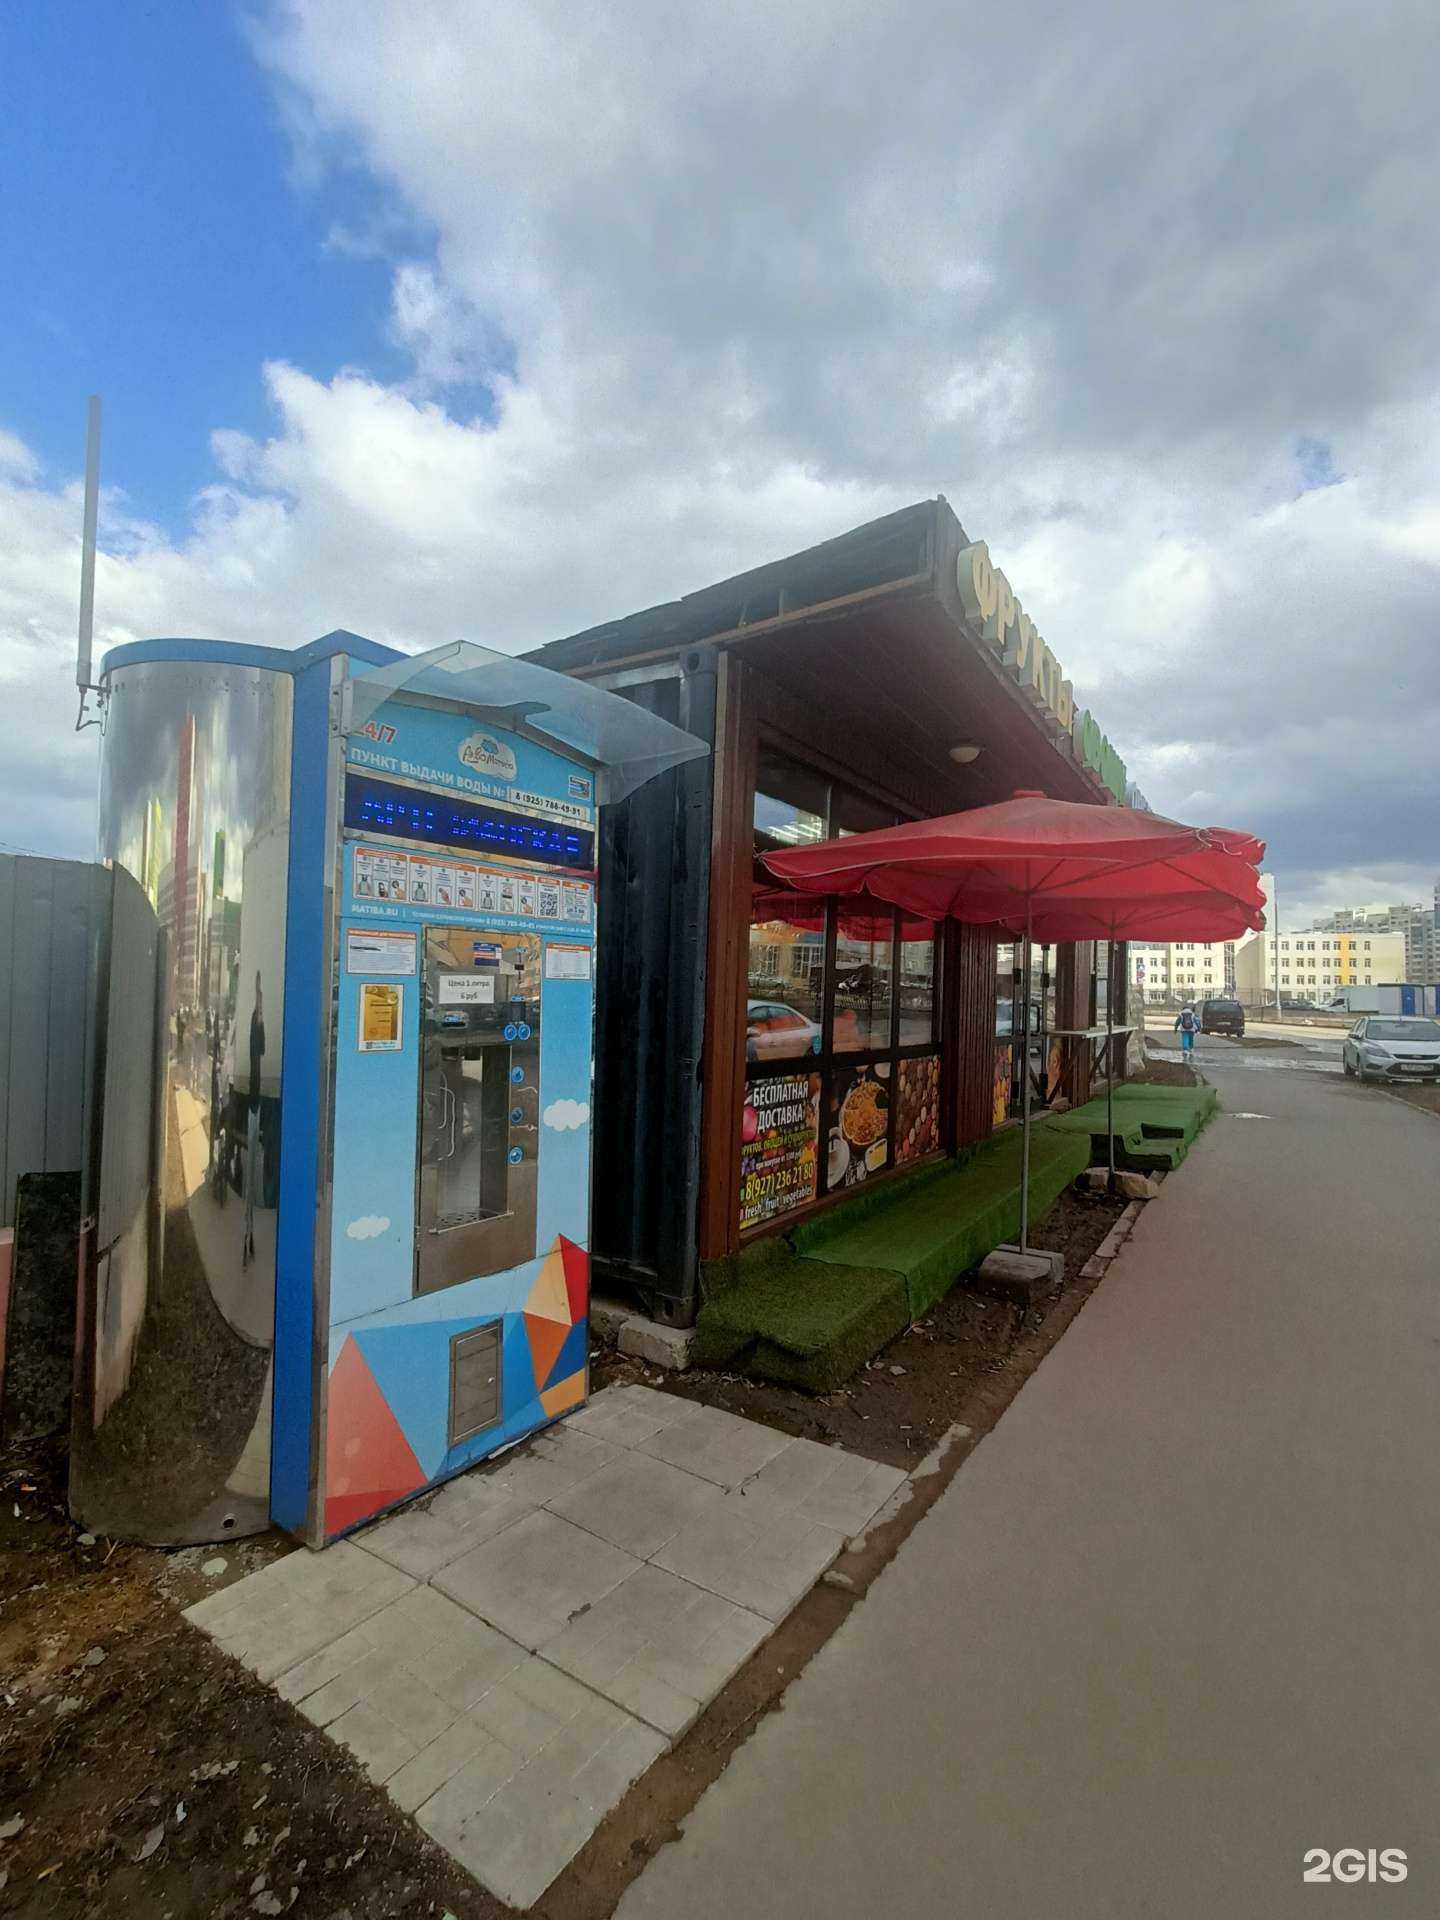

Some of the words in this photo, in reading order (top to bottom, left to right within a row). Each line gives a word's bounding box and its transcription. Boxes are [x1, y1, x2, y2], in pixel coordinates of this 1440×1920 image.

[351, 747, 399, 771] ПУНКТ
[401, 762, 454, 785] ВЫДАЧИ
[456, 776, 491, 795] ВОДЫ
[753, 1080, 809, 1107] БЕСПЛАТНАЯ
[757, 1103, 803, 1134] ДОСТАВКА
[745, 1173, 775, 1202] 8(927)
[775, 1168, 792, 1190] 236
[792, 1165, 803, 1185] 21
[803, 1162, 814, 1180] 80
[745, 1201, 762, 1220] fresh
[765, 1195, 780, 1211] fruit
[782, 1184, 813, 1205] vegetables
